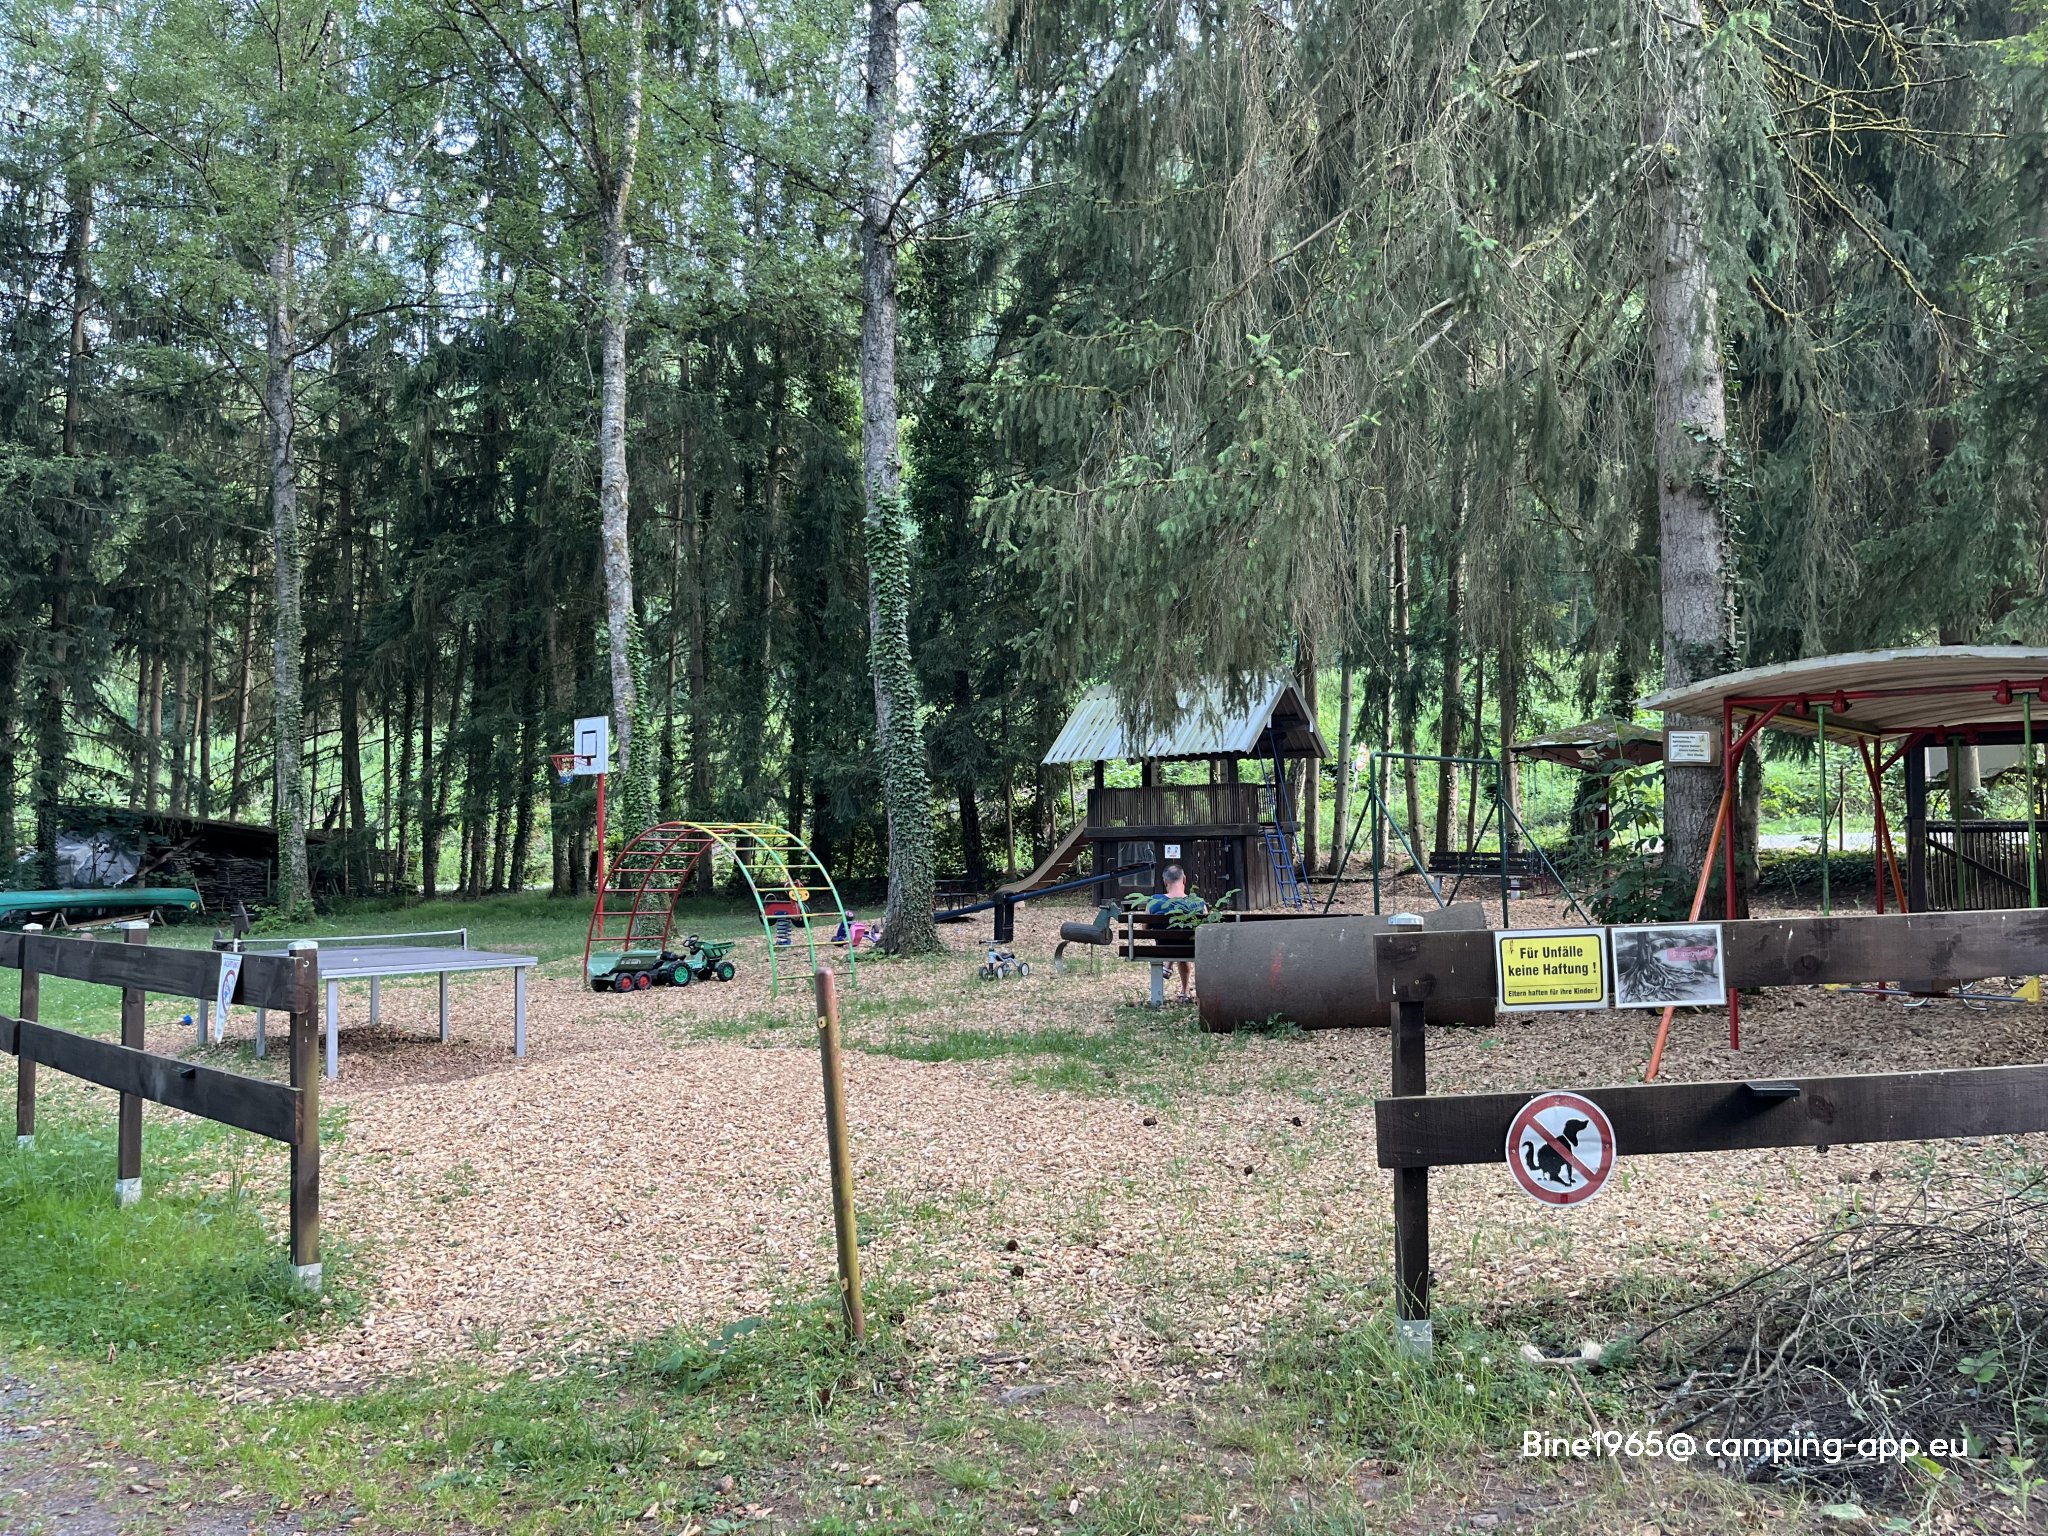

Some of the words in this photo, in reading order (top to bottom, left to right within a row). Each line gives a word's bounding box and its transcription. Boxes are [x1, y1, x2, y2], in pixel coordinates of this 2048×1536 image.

[1520, 947, 1538, 959] Für
[1543, 946, 1583, 958] Unfälle
[1508, 965, 1539, 976] keine
[1543, 963, 1588, 976] Haftung
